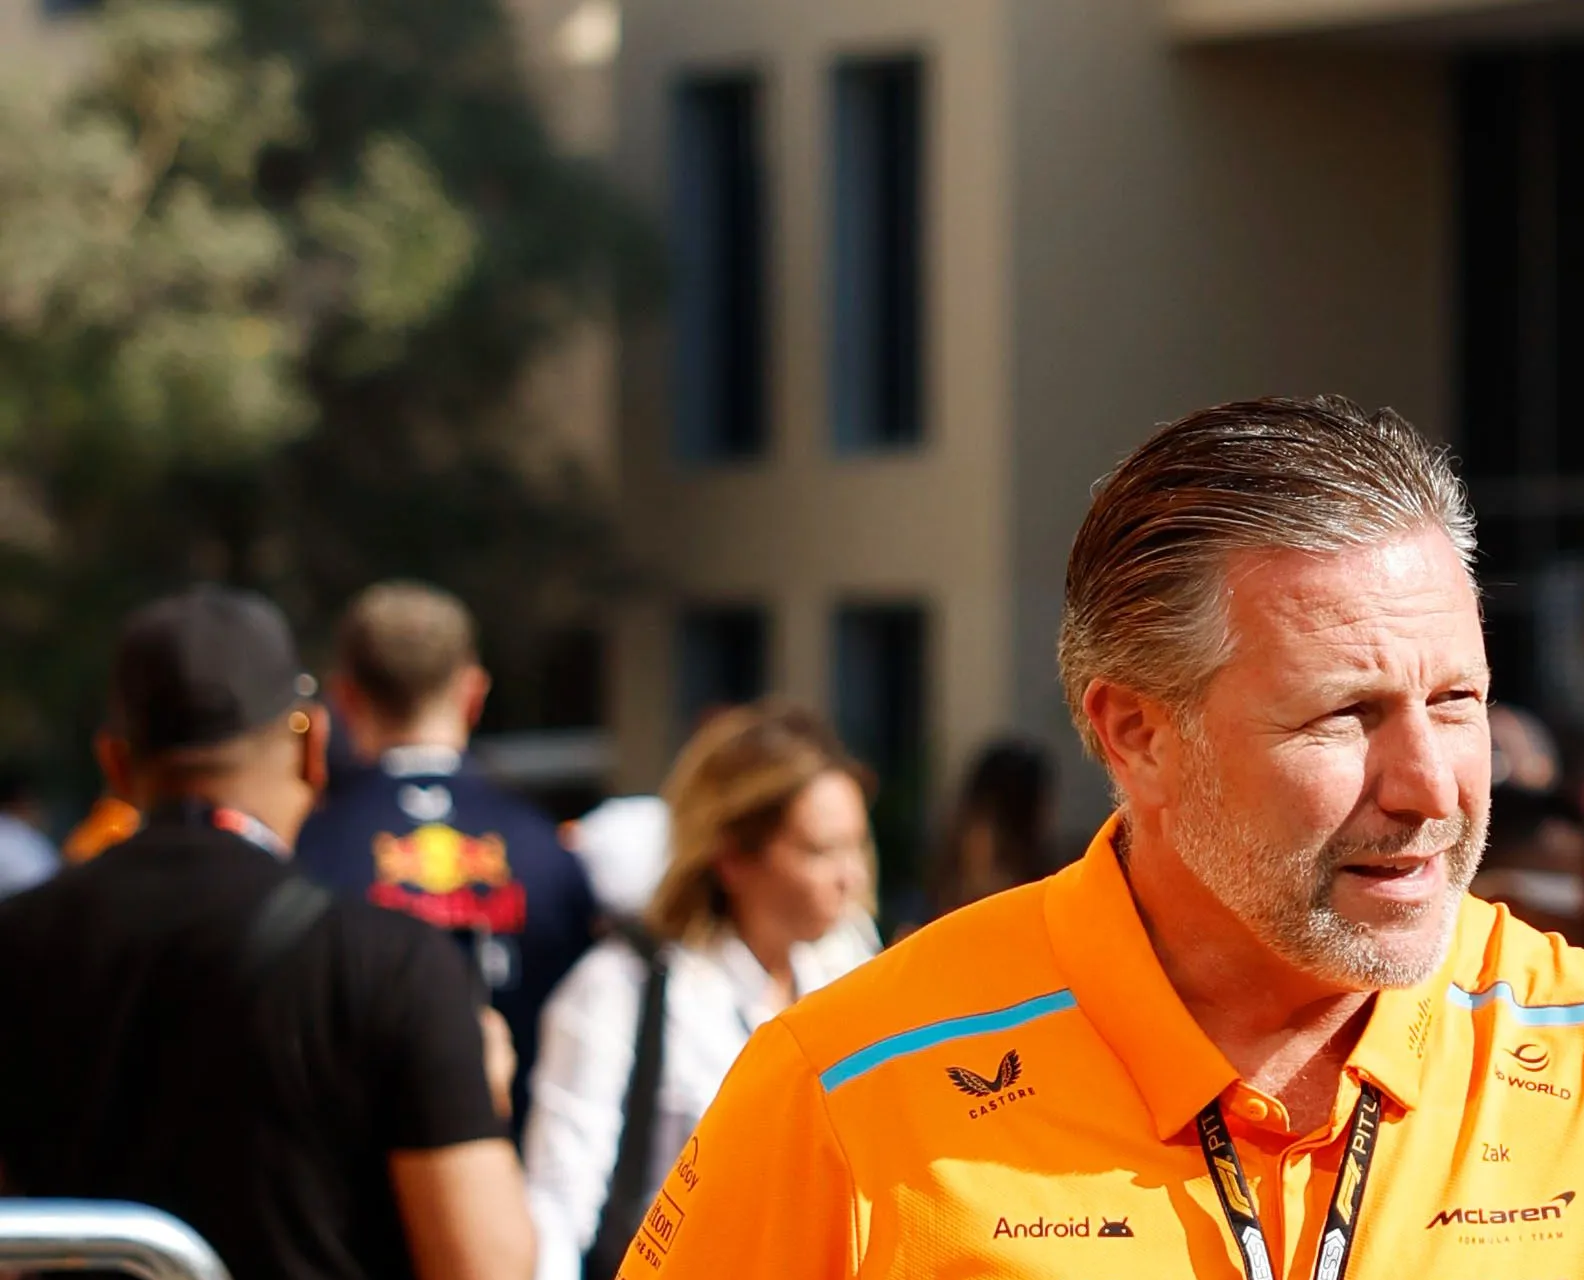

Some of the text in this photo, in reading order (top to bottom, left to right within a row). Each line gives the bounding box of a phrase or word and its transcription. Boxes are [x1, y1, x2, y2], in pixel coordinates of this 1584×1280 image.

[1508, 1075, 1571, 1101] WORLD
[969, 1086, 1036, 1120] CASTORE
[1351, 1101, 1378, 1155] PITL
[1482, 1143, 1511, 1162] Zak
[993, 1216, 1090, 1240] Android
[1425, 1205, 1561, 1230] McLaren
[1458, 1235, 1510, 1246] FORMULA
[1532, 1231, 1564, 1242] TEAM
